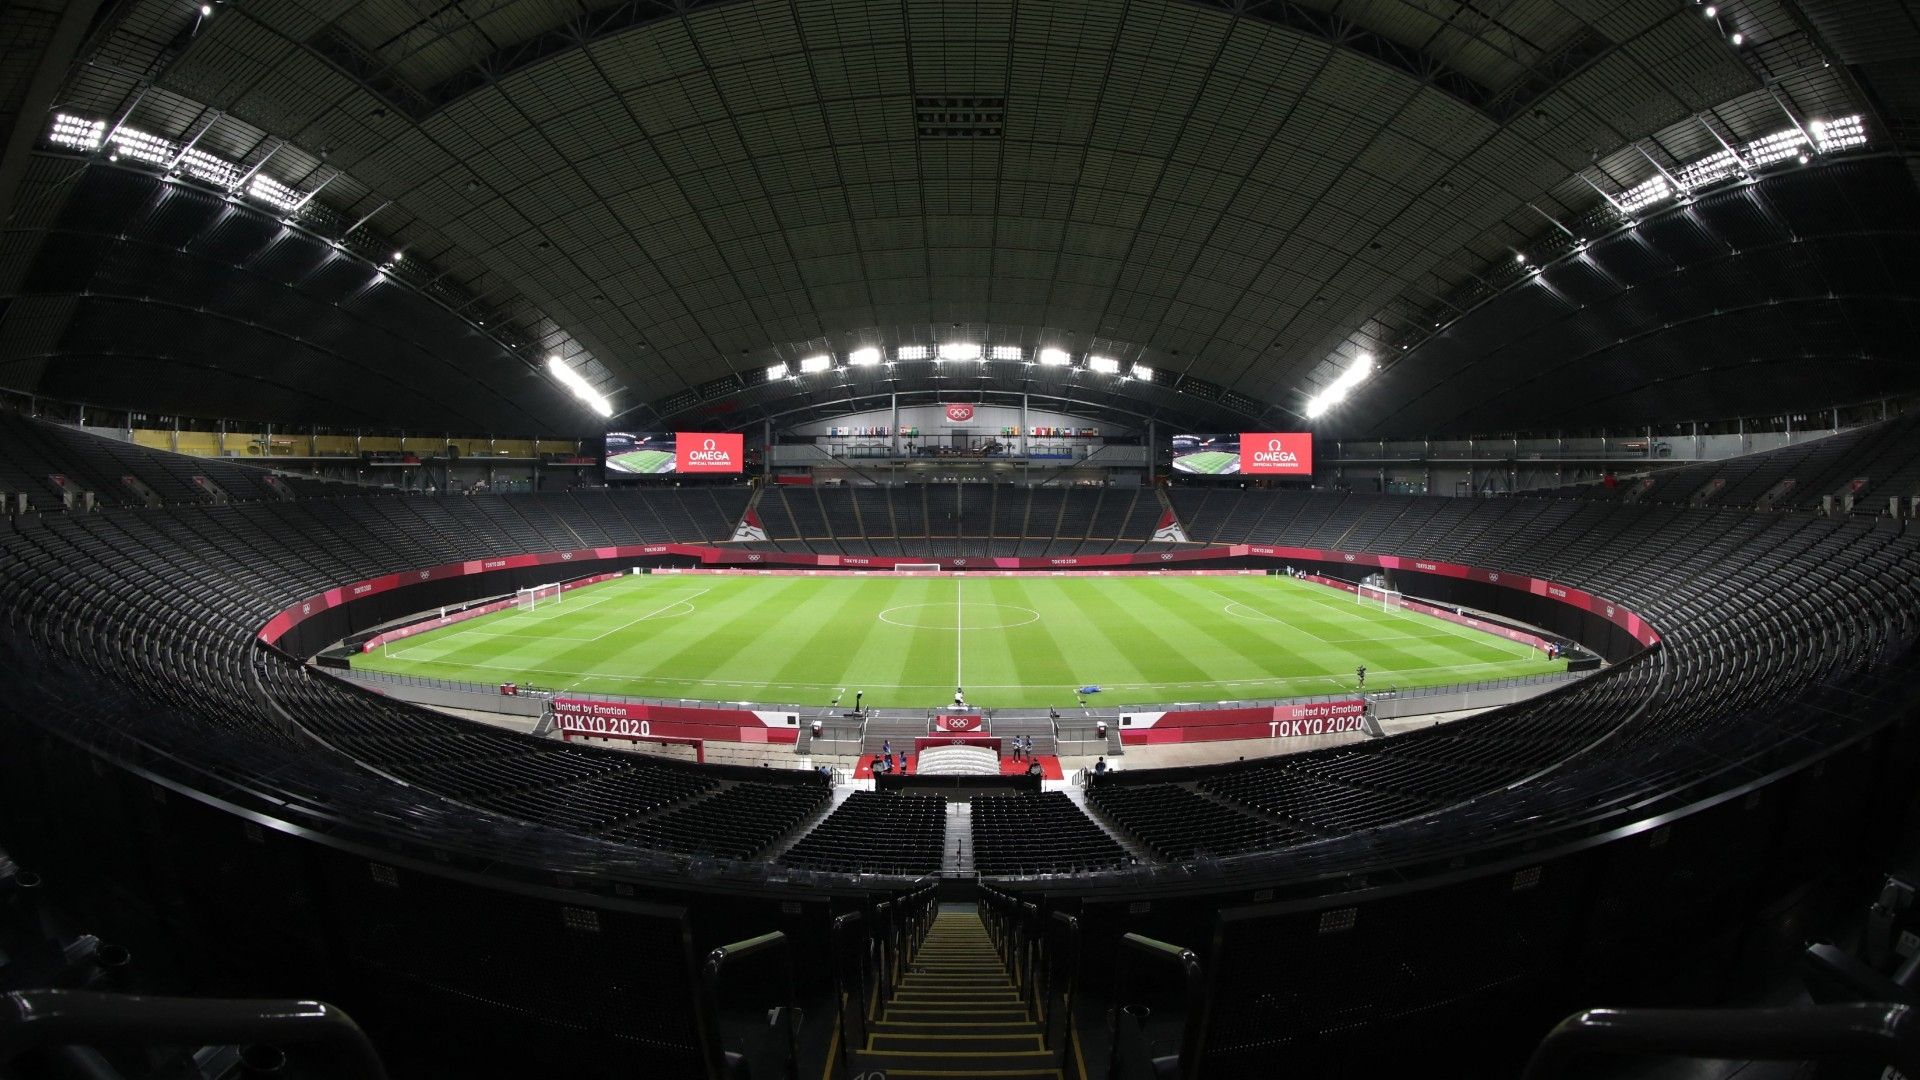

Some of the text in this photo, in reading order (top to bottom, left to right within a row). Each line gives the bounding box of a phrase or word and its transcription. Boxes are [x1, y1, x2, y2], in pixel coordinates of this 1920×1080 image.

[689, 451, 730, 460] OMEGA
[1254, 452, 1297, 461] OMEGA
[555, 702, 626, 715] United by Emotion
[1292, 705, 1361, 717] United by Emotion
[554, 713, 650, 736] TOKYO 2020
[1269, 715, 1364, 737] TOKYO 2020
